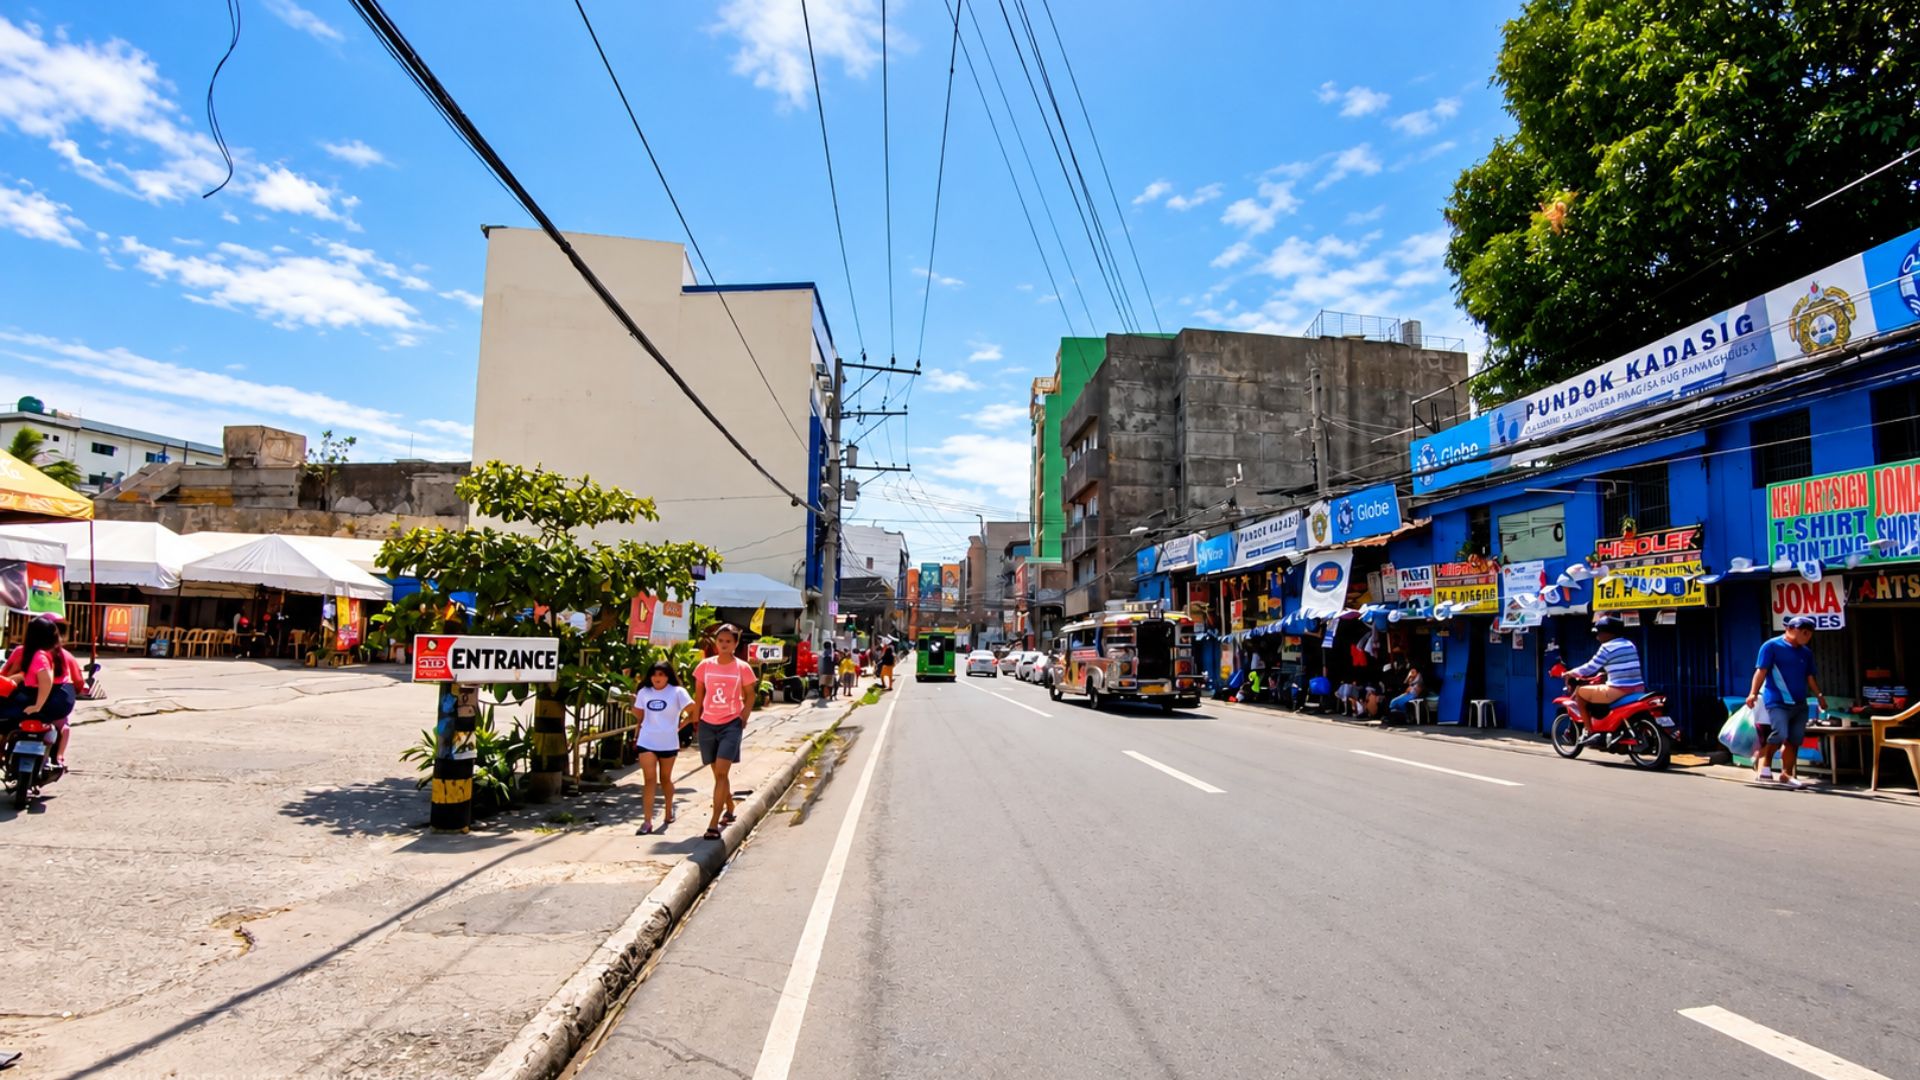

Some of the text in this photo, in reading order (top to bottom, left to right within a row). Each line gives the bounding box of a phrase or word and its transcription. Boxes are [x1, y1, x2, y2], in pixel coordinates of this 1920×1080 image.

[1525, 313, 1754, 421] PUNDOK KADASIG
[1357, 501, 1390, 521] Globe
[1771, 472, 1869, 519] NEW ARTSIGN
[1774, 509, 1869, 542] T-SHIRT
[1876, 514, 1920, 557] SHOE
[1775, 535, 1870, 569] PRINTING
[1773, 581, 1842, 614] JOMA
[452, 648, 557, 670] ENTRANCE
